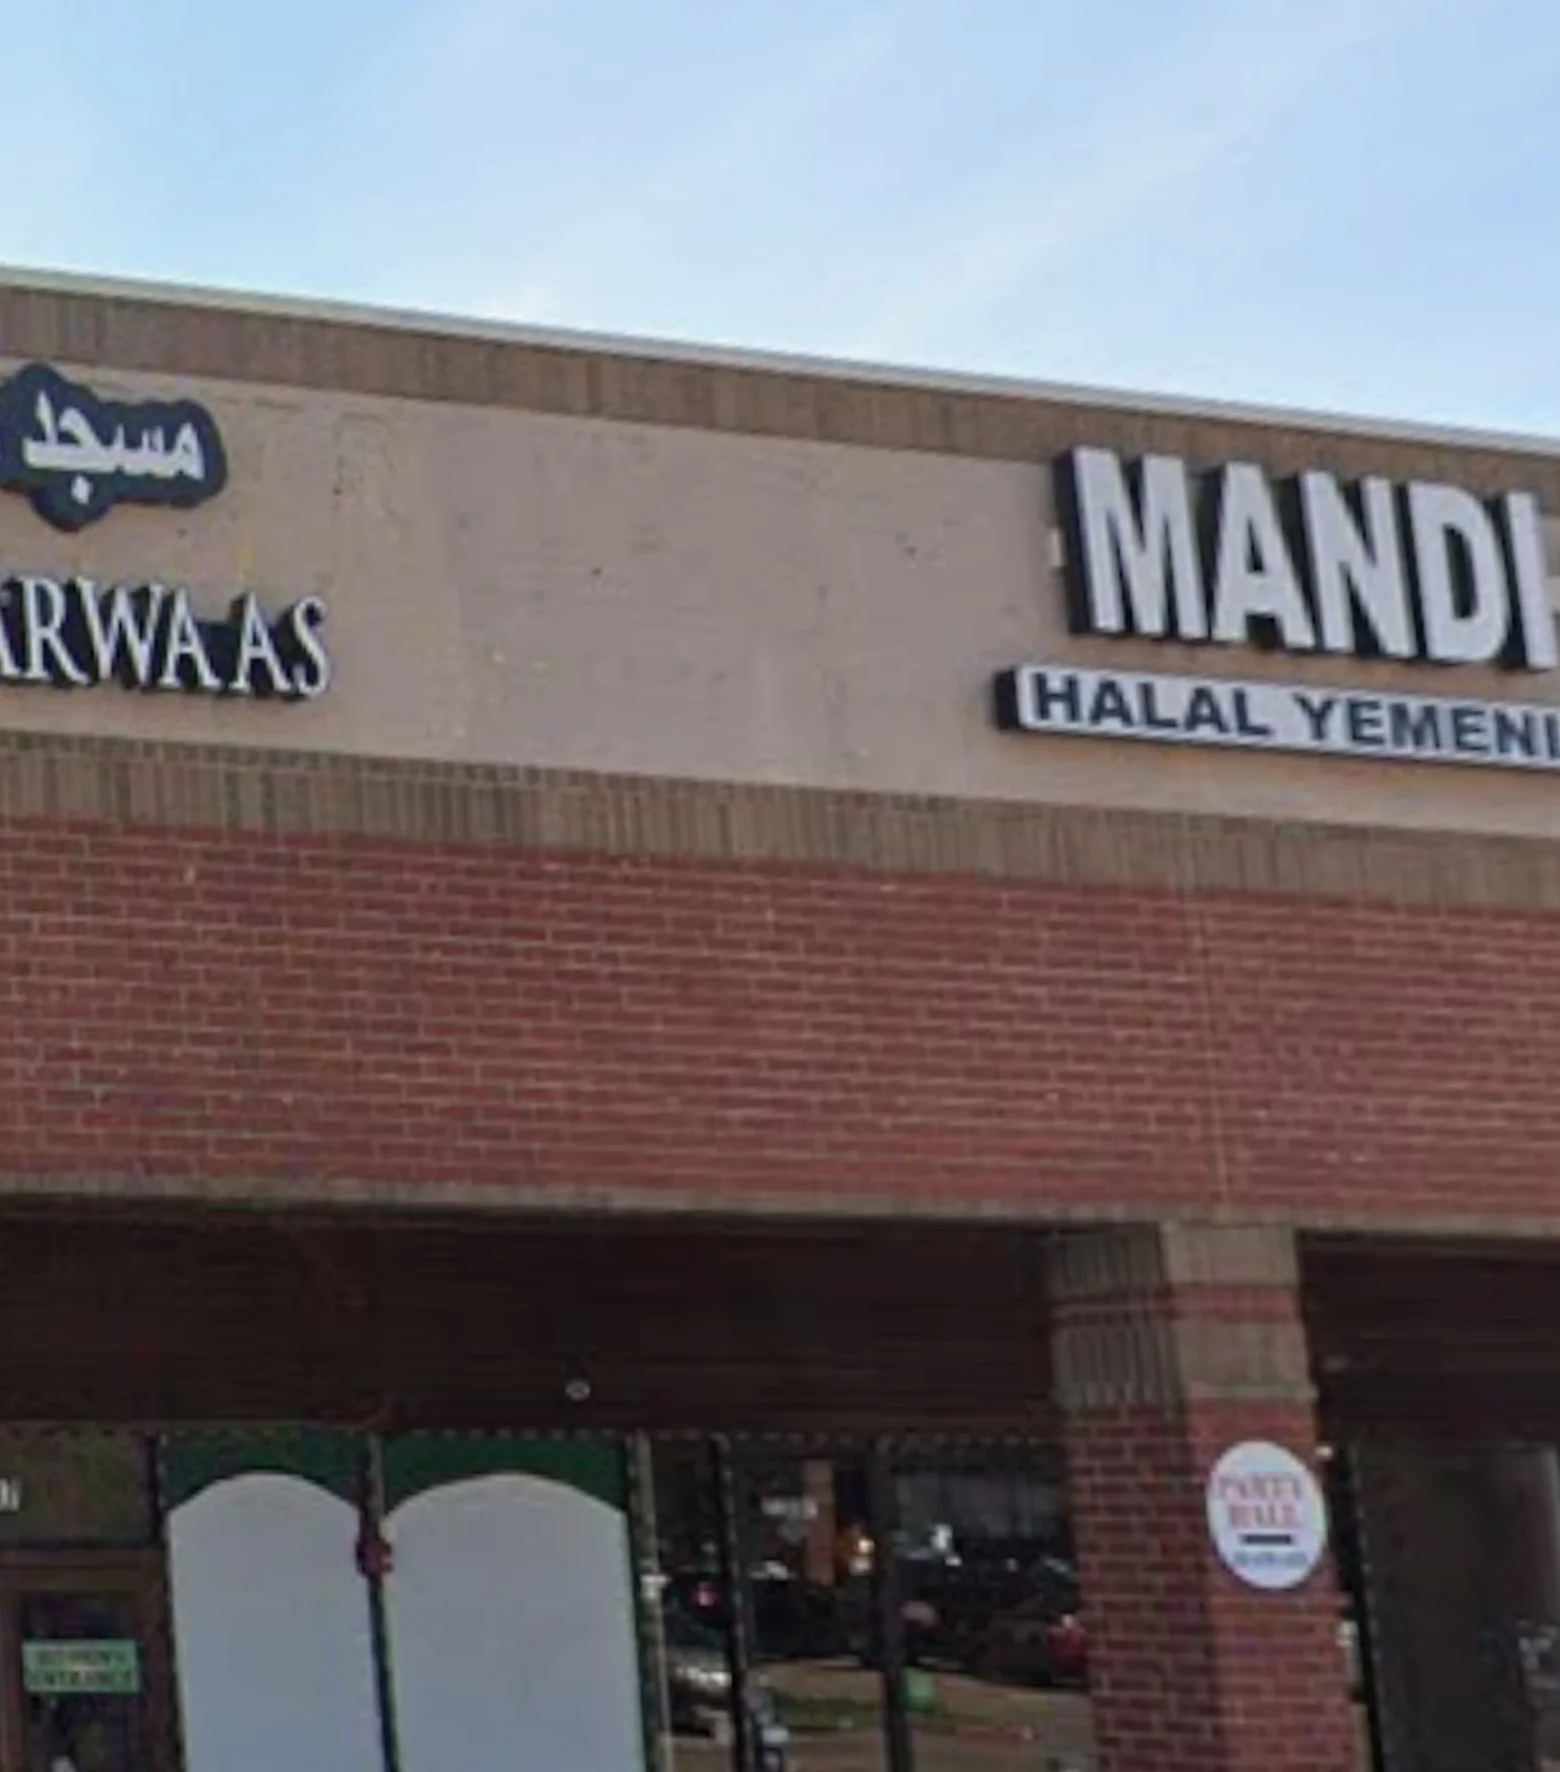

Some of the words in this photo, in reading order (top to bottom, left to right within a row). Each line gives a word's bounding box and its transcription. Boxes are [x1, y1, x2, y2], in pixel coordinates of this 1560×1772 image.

[19, 388, 207, 504] مسجد
[1071, 444, 1559, 672] MANDI
[1032, 671, 1272, 736] HALAL
